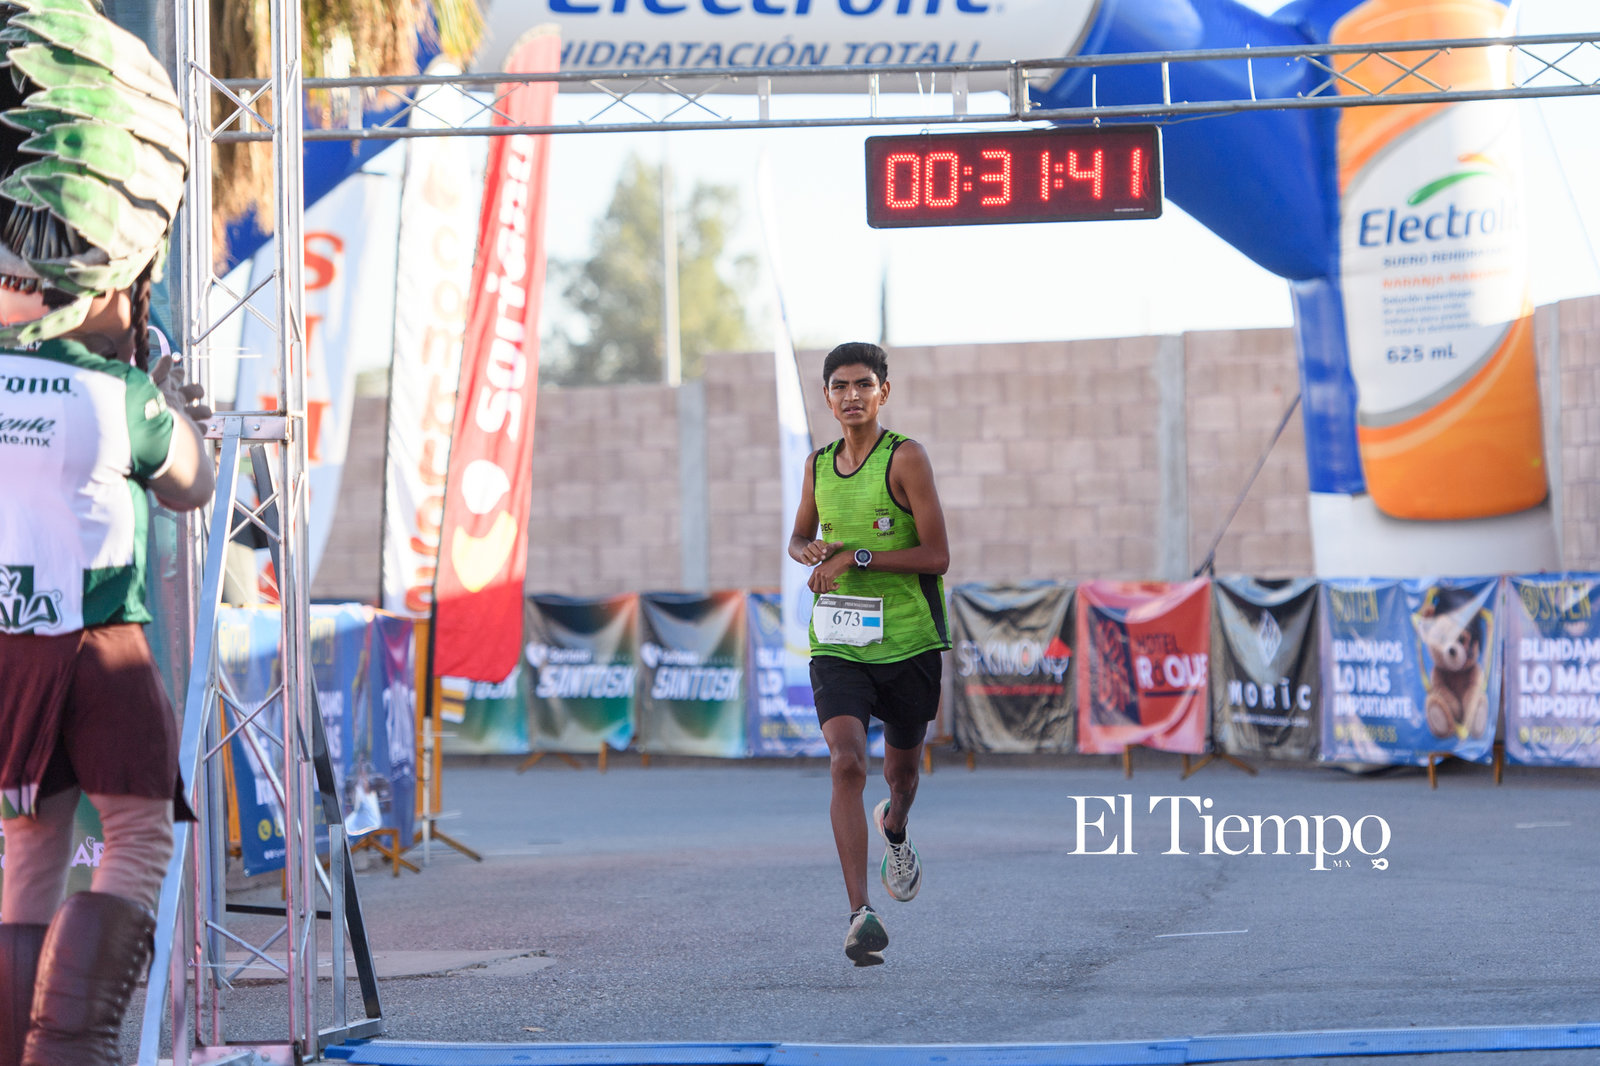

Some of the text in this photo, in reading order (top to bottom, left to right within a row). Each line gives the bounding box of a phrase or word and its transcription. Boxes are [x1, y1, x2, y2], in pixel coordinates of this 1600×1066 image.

[886, 148, 1141, 208] 00:31:41
[1358, 197, 1520, 247] Electrol
[1386, 345, 1424, 363] 625
[832, 610, 861, 627] 673
[1333, 664, 1356, 693] LO
[1519, 664, 1552, 693] LO
